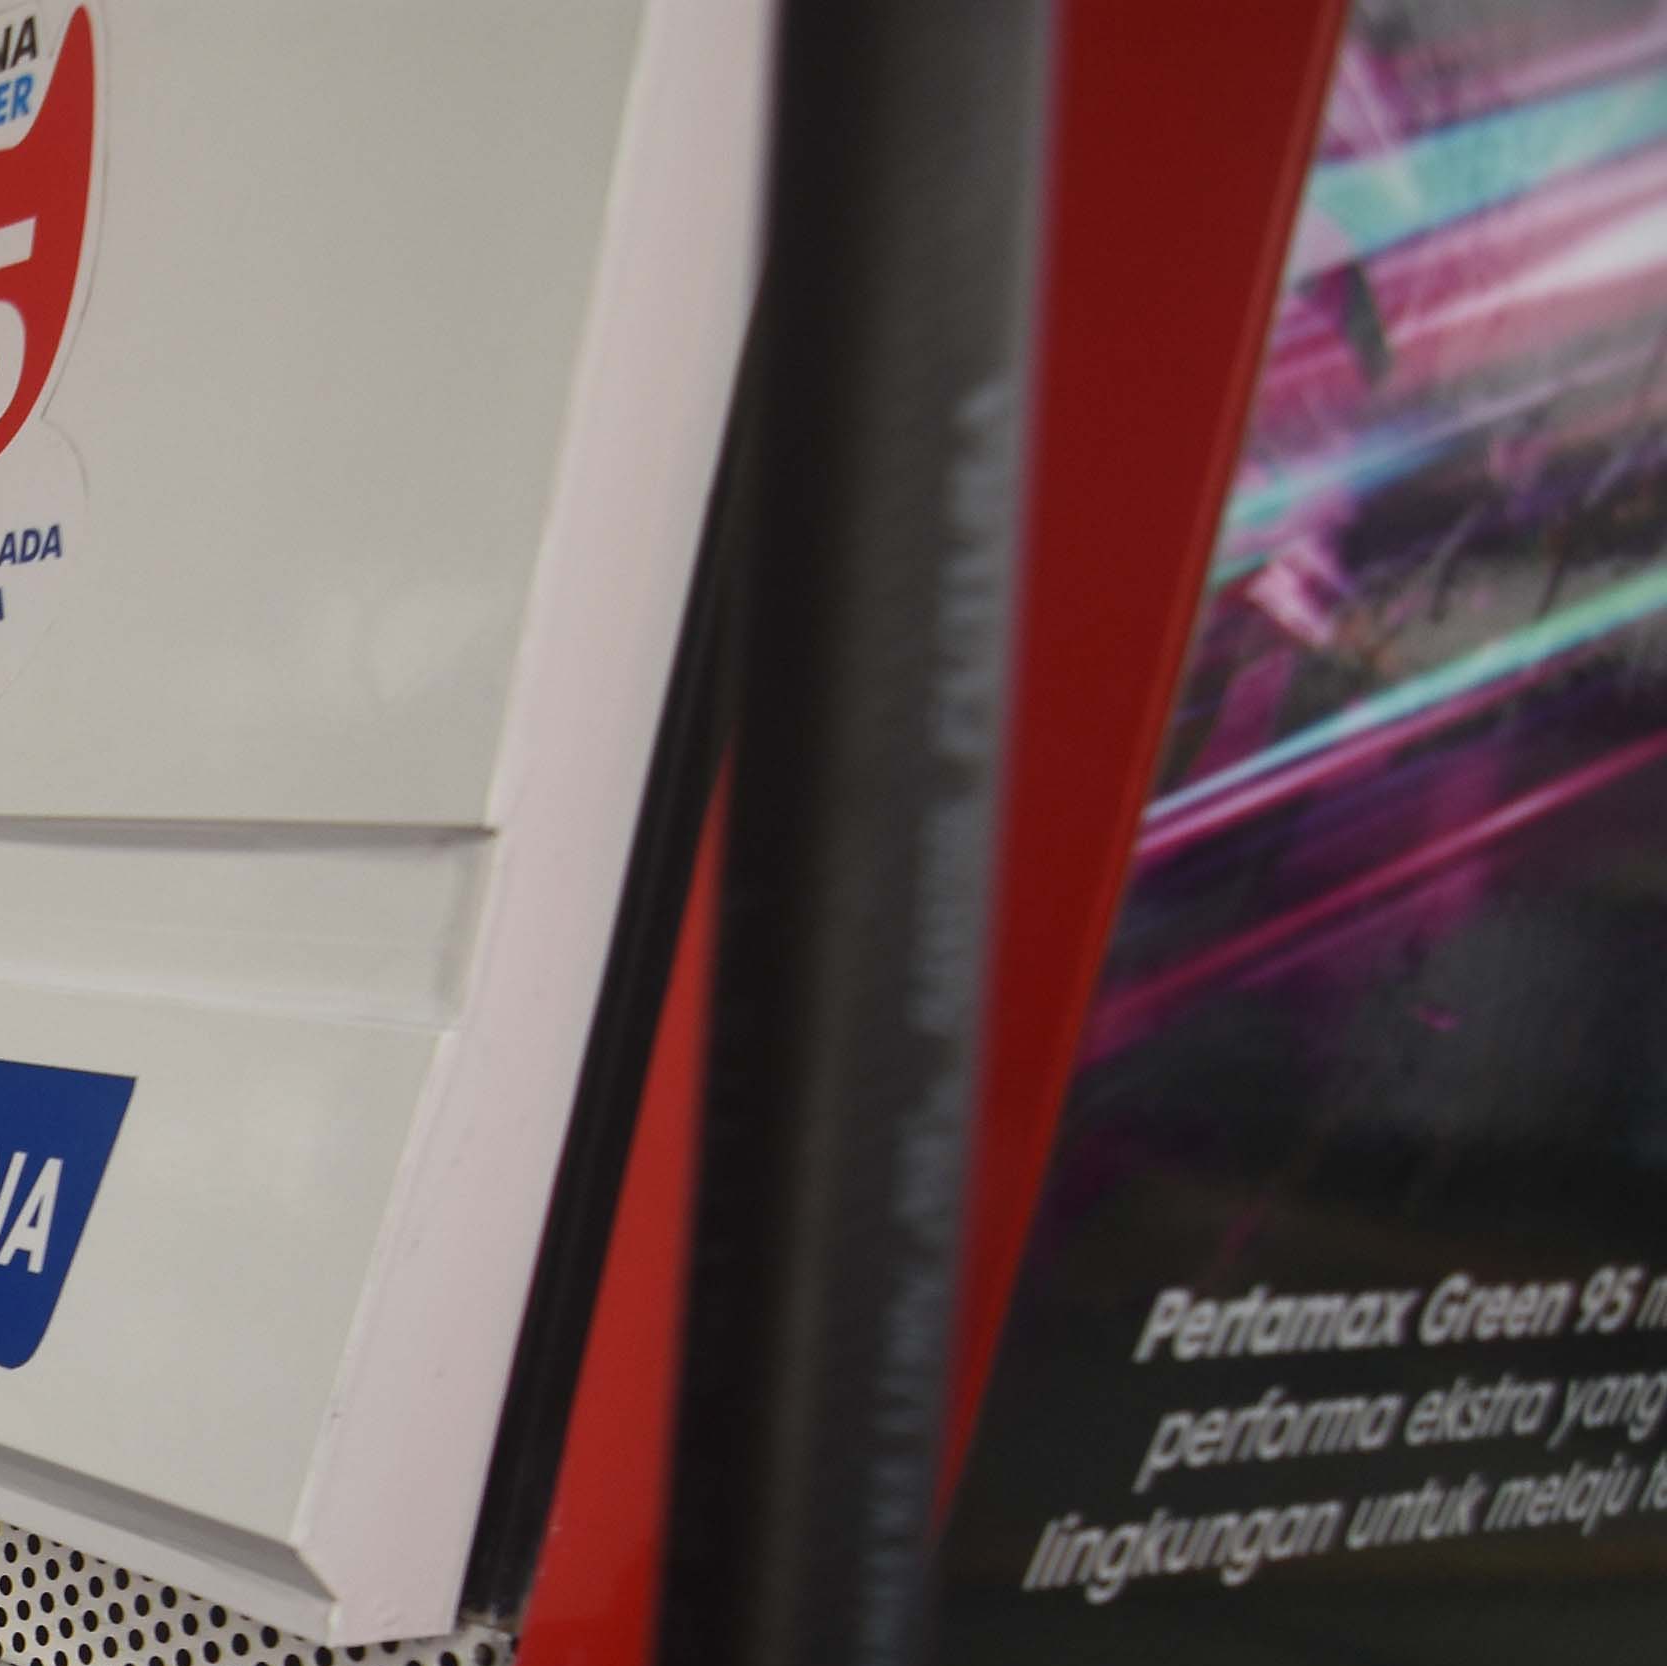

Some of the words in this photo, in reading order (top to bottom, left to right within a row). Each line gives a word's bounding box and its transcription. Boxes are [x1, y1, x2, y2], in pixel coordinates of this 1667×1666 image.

[1134, 1287, 1418, 1362] Pertamax
[1418, 1272, 1571, 1345] Green
[1575, 1266, 1644, 1334] 95
[1134, 1387, 1400, 1492] performa
[1406, 1373, 1553, 1446] ekstra
[1022, 1502, 1340, 1603] lingkungan
[1347, 1477, 1484, 1549] untuk
[1486, 1453, 1637, 1534] melaju
